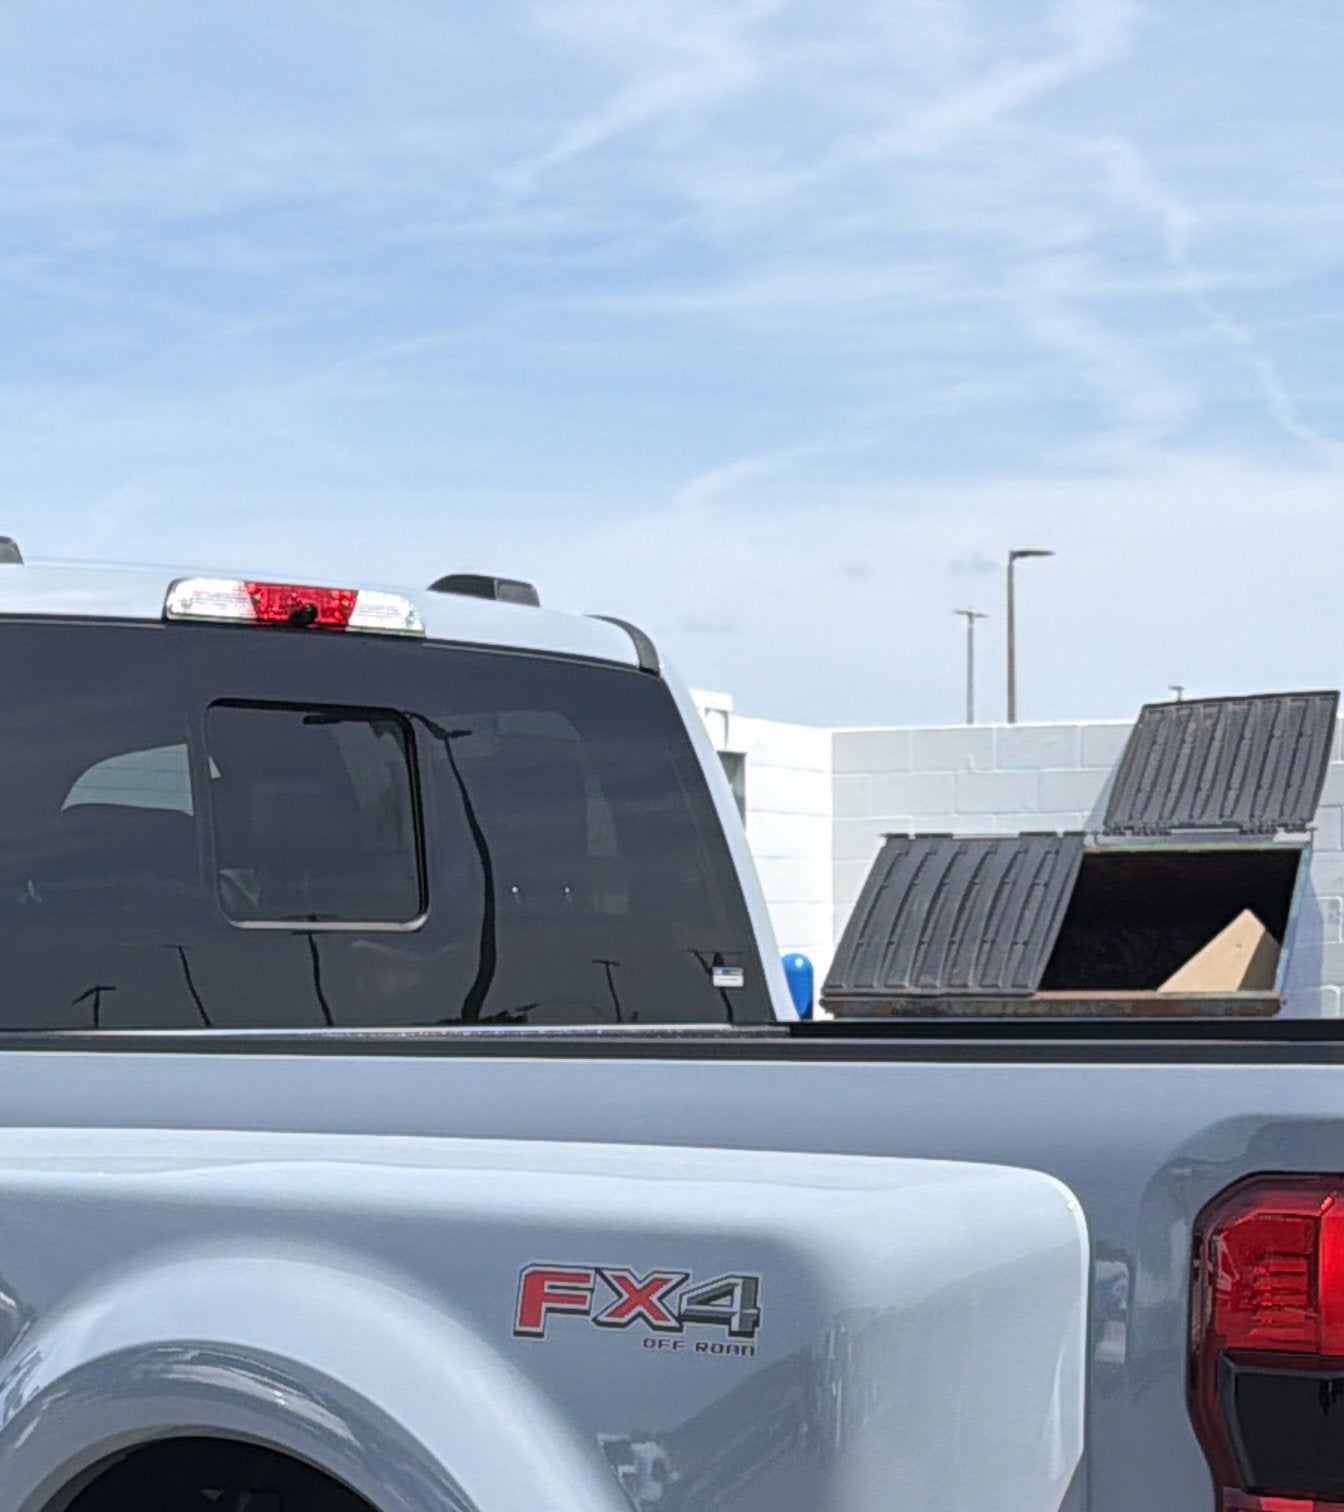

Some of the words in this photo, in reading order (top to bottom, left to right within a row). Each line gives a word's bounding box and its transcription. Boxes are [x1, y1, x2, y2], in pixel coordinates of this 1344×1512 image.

[513, 1262, 761, 1338] FX4
[642, 1338, 687, 1351] OFF
[695, 1341, 755, 1357] ROAD
